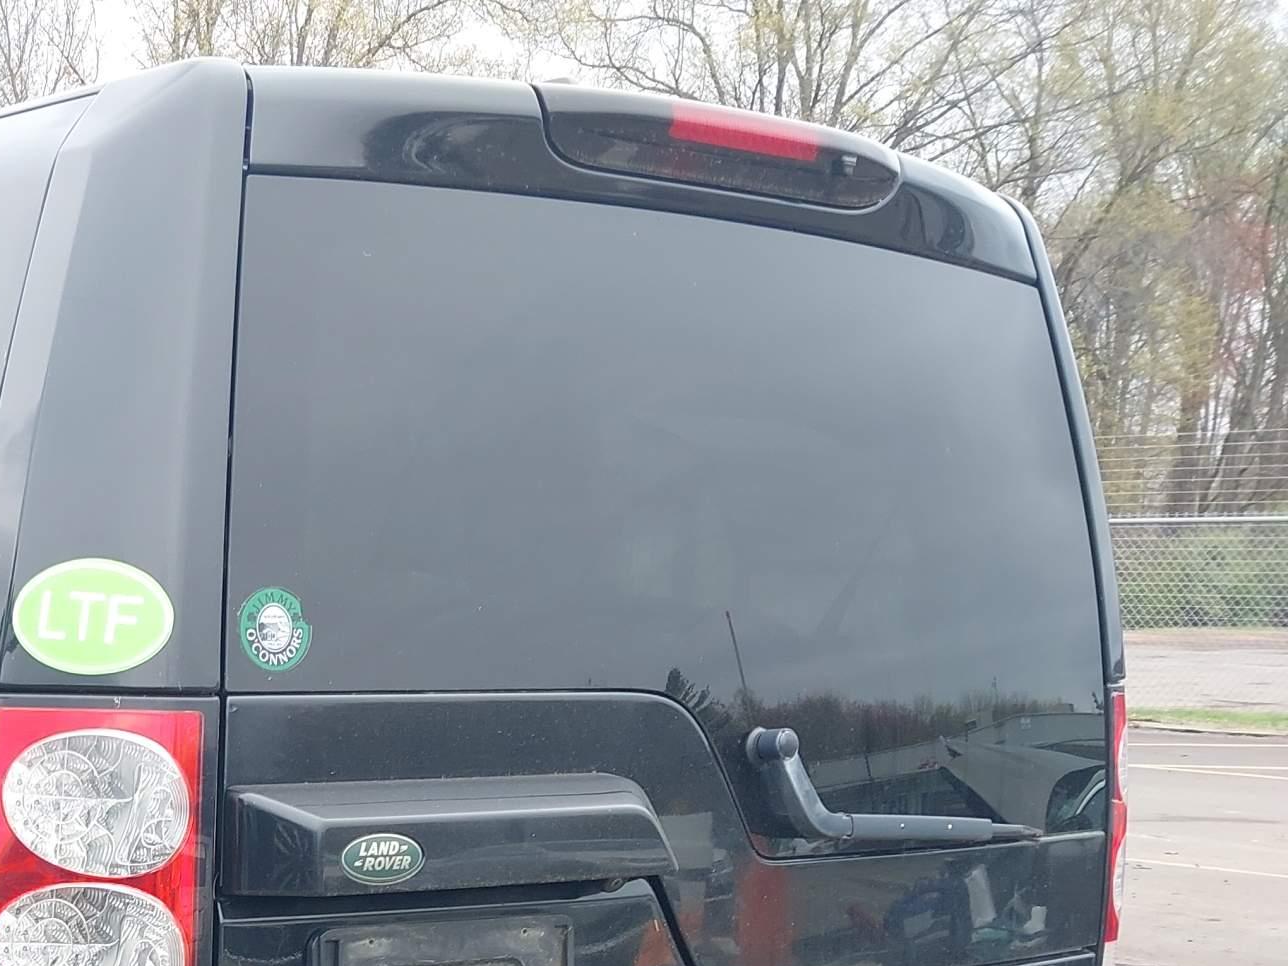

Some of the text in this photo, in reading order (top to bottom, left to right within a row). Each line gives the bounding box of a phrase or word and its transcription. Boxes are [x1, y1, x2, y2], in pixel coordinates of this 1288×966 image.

[37, 590, 145, 645] LTF
[246, 628, 303, 666] O'CONNORS
[358, 841, 398, 856] LAND
[362, 855, 411, 871] ROVER
